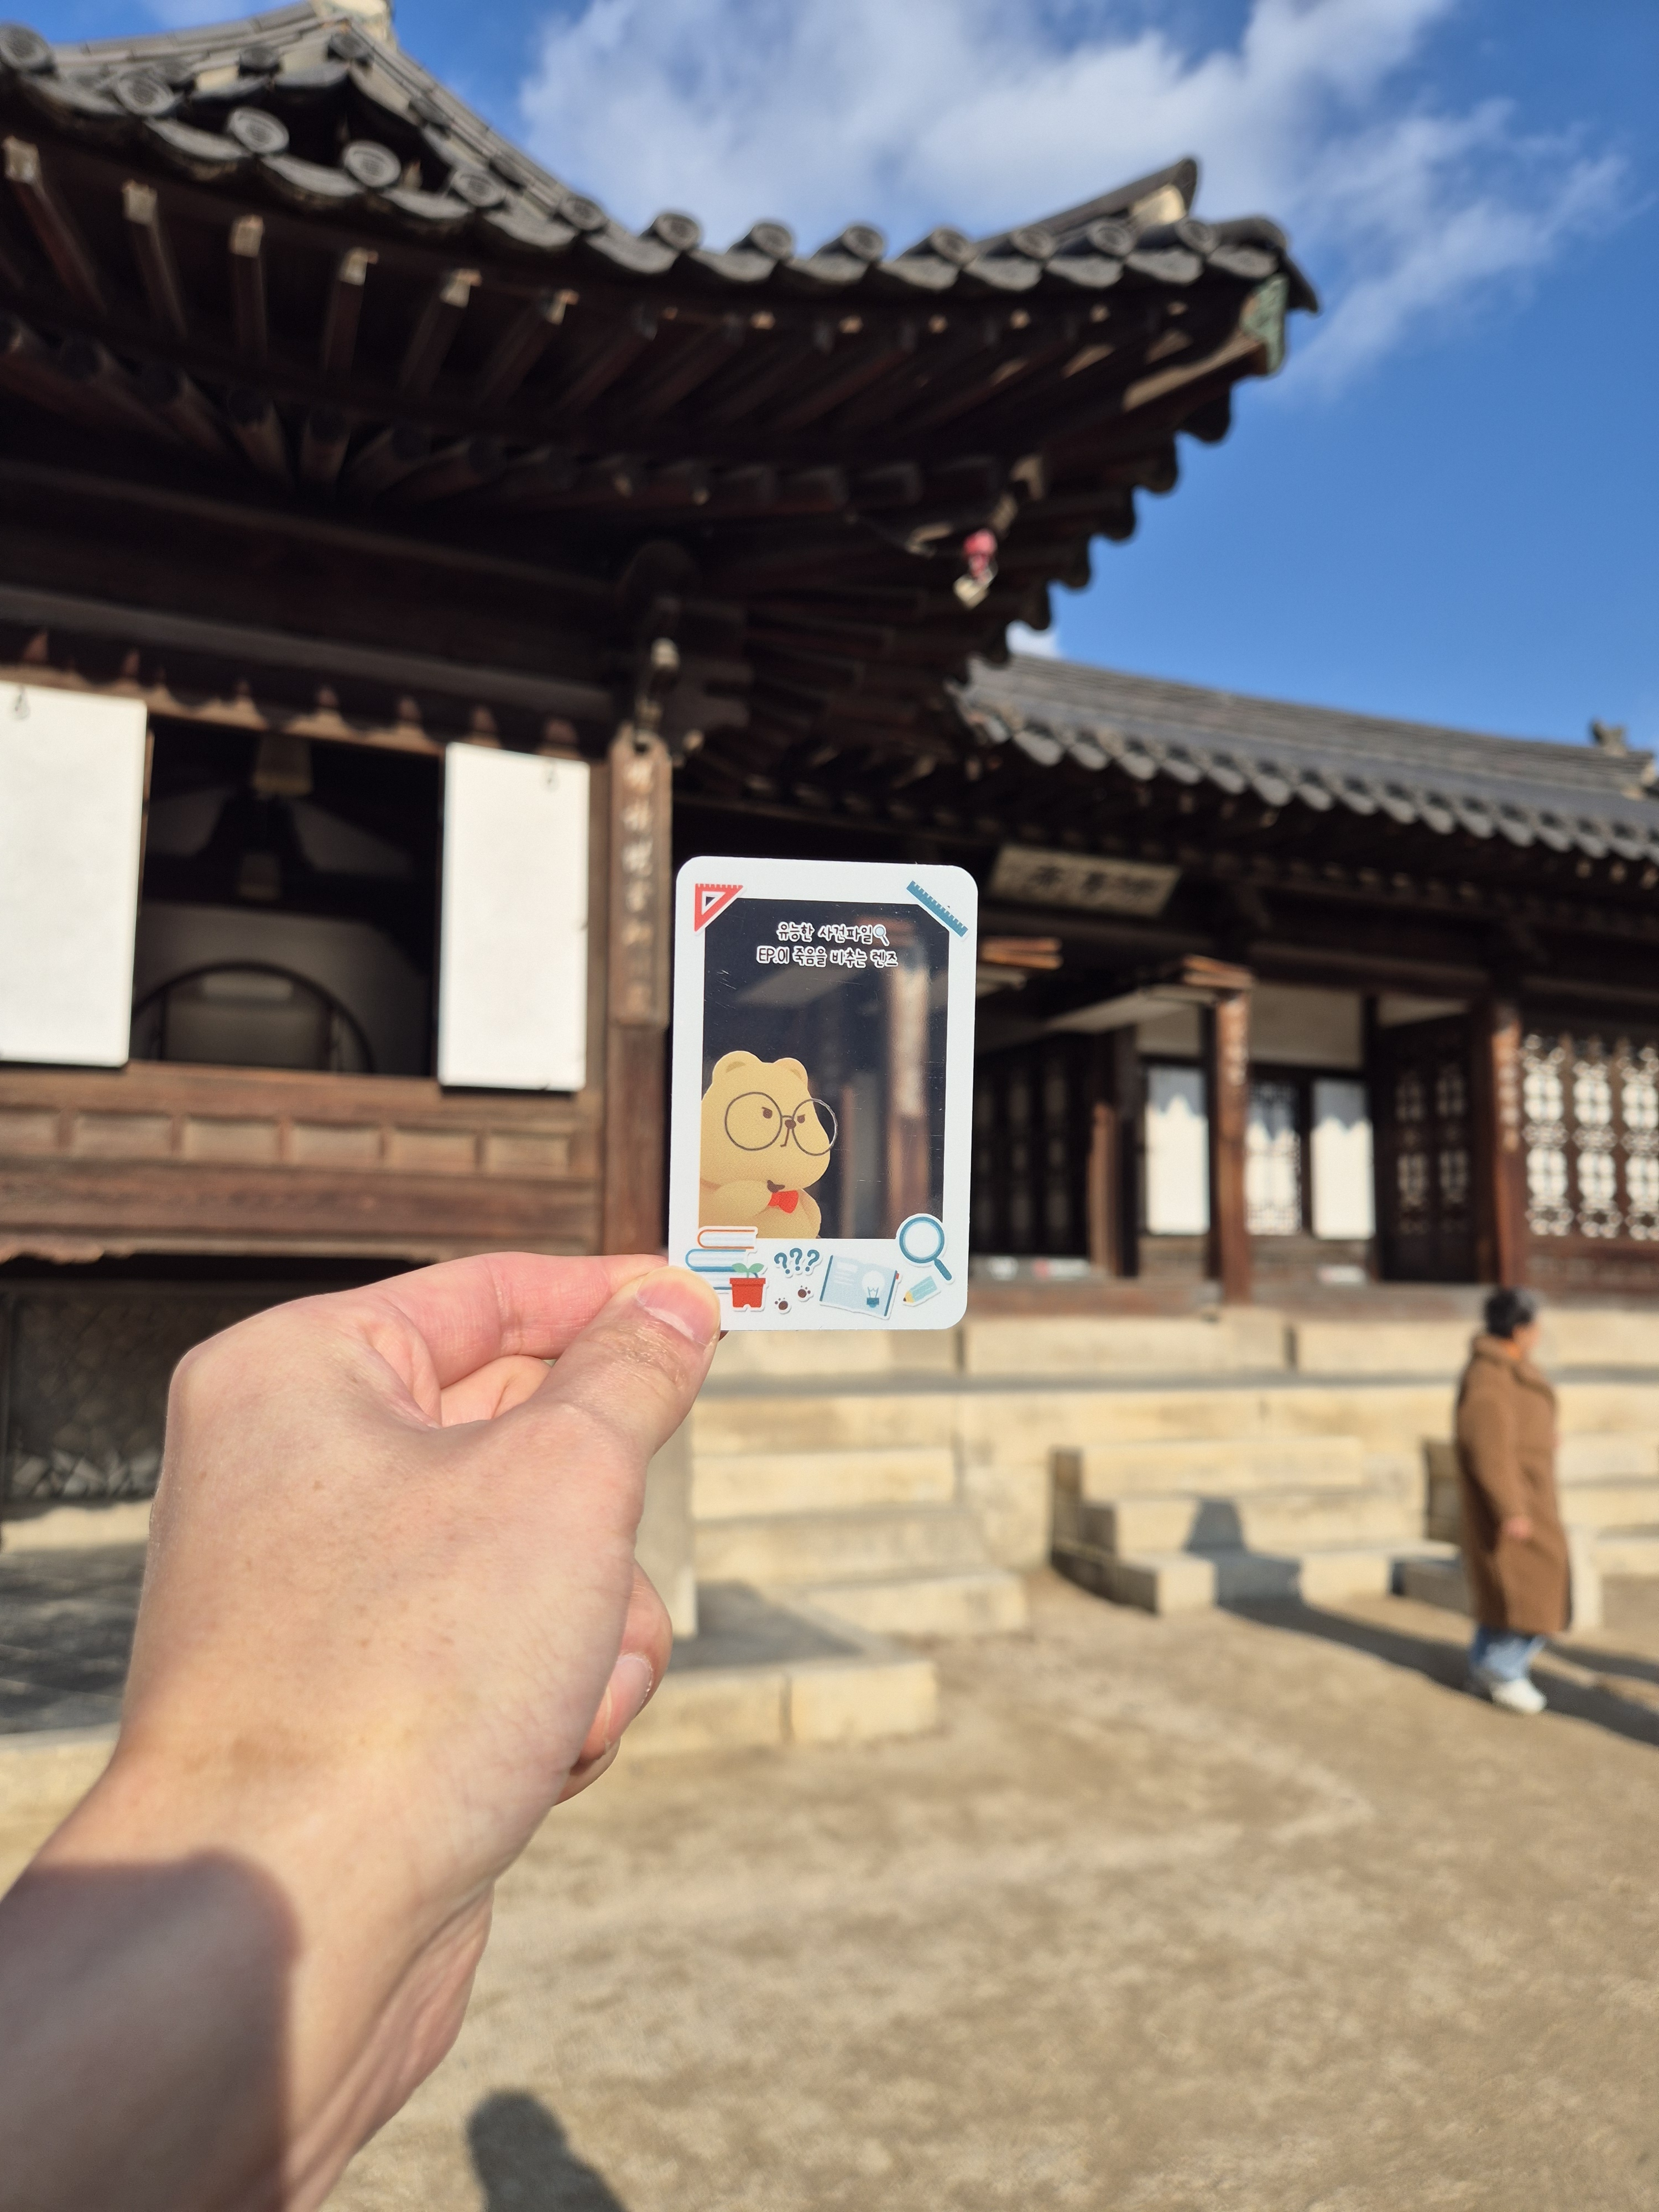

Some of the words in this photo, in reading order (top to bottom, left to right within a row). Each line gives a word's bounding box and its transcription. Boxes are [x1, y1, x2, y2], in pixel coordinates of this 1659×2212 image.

[778, 923, 814, 941] 유능한
[819, 924, 872, 943] 사건파일
[793, 947, 827, 966] 죽음을
[831, 948, 867, 967] 비추는
[871, 950, 898, 967] 렌즈
